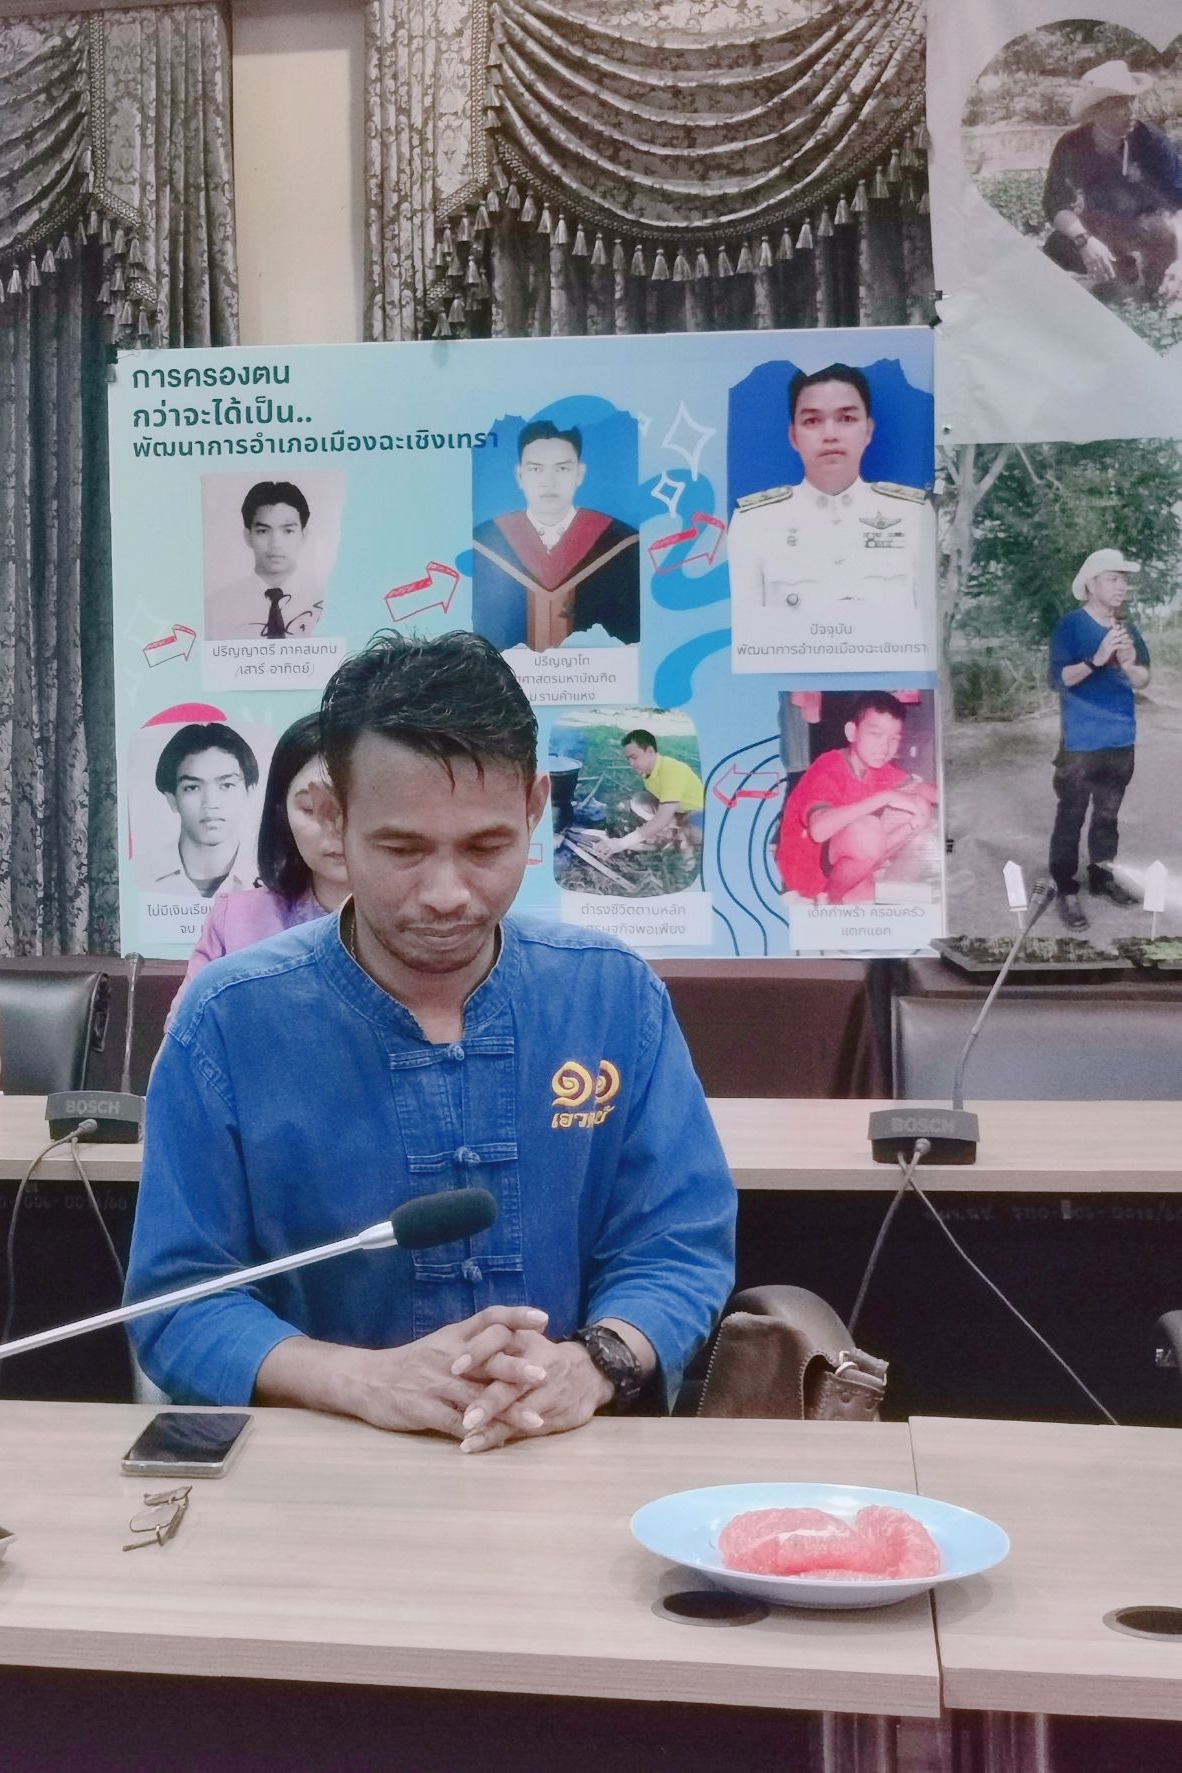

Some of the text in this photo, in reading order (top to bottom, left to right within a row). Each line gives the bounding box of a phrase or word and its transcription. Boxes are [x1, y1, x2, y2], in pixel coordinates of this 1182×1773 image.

[132, 364, 291, 389] การครองตน
[132, 396, 313, 428] กว่าจะได้เป็น..
[132, 429, 499, 458] พัฒนาการอำเภอเมืองฉะเชิงเทรา
[809, 622, 854, 638] ปัจจุบัน
[212, 643, 338, 658] ปริญญาตรี ภาคสมทบ
[736, 641, 928, 656] พัฒนาการอำเภอเมืองฉะเชิงเทรา
[534, 653, 591, 668] ปริญญาโท
[146, 903, 212, 917] ไม่มีเงินเรีย
[581, 902, 687, 916] ดำรงชีวิตตามหลัก
[870, 905, 926, 918] ครอบครัว
[841, 926, 892, 937] แตกแยก
[65, 1100, 120, 1115] BOSCH
[890, 1117, 955, 1132] BOSCH
